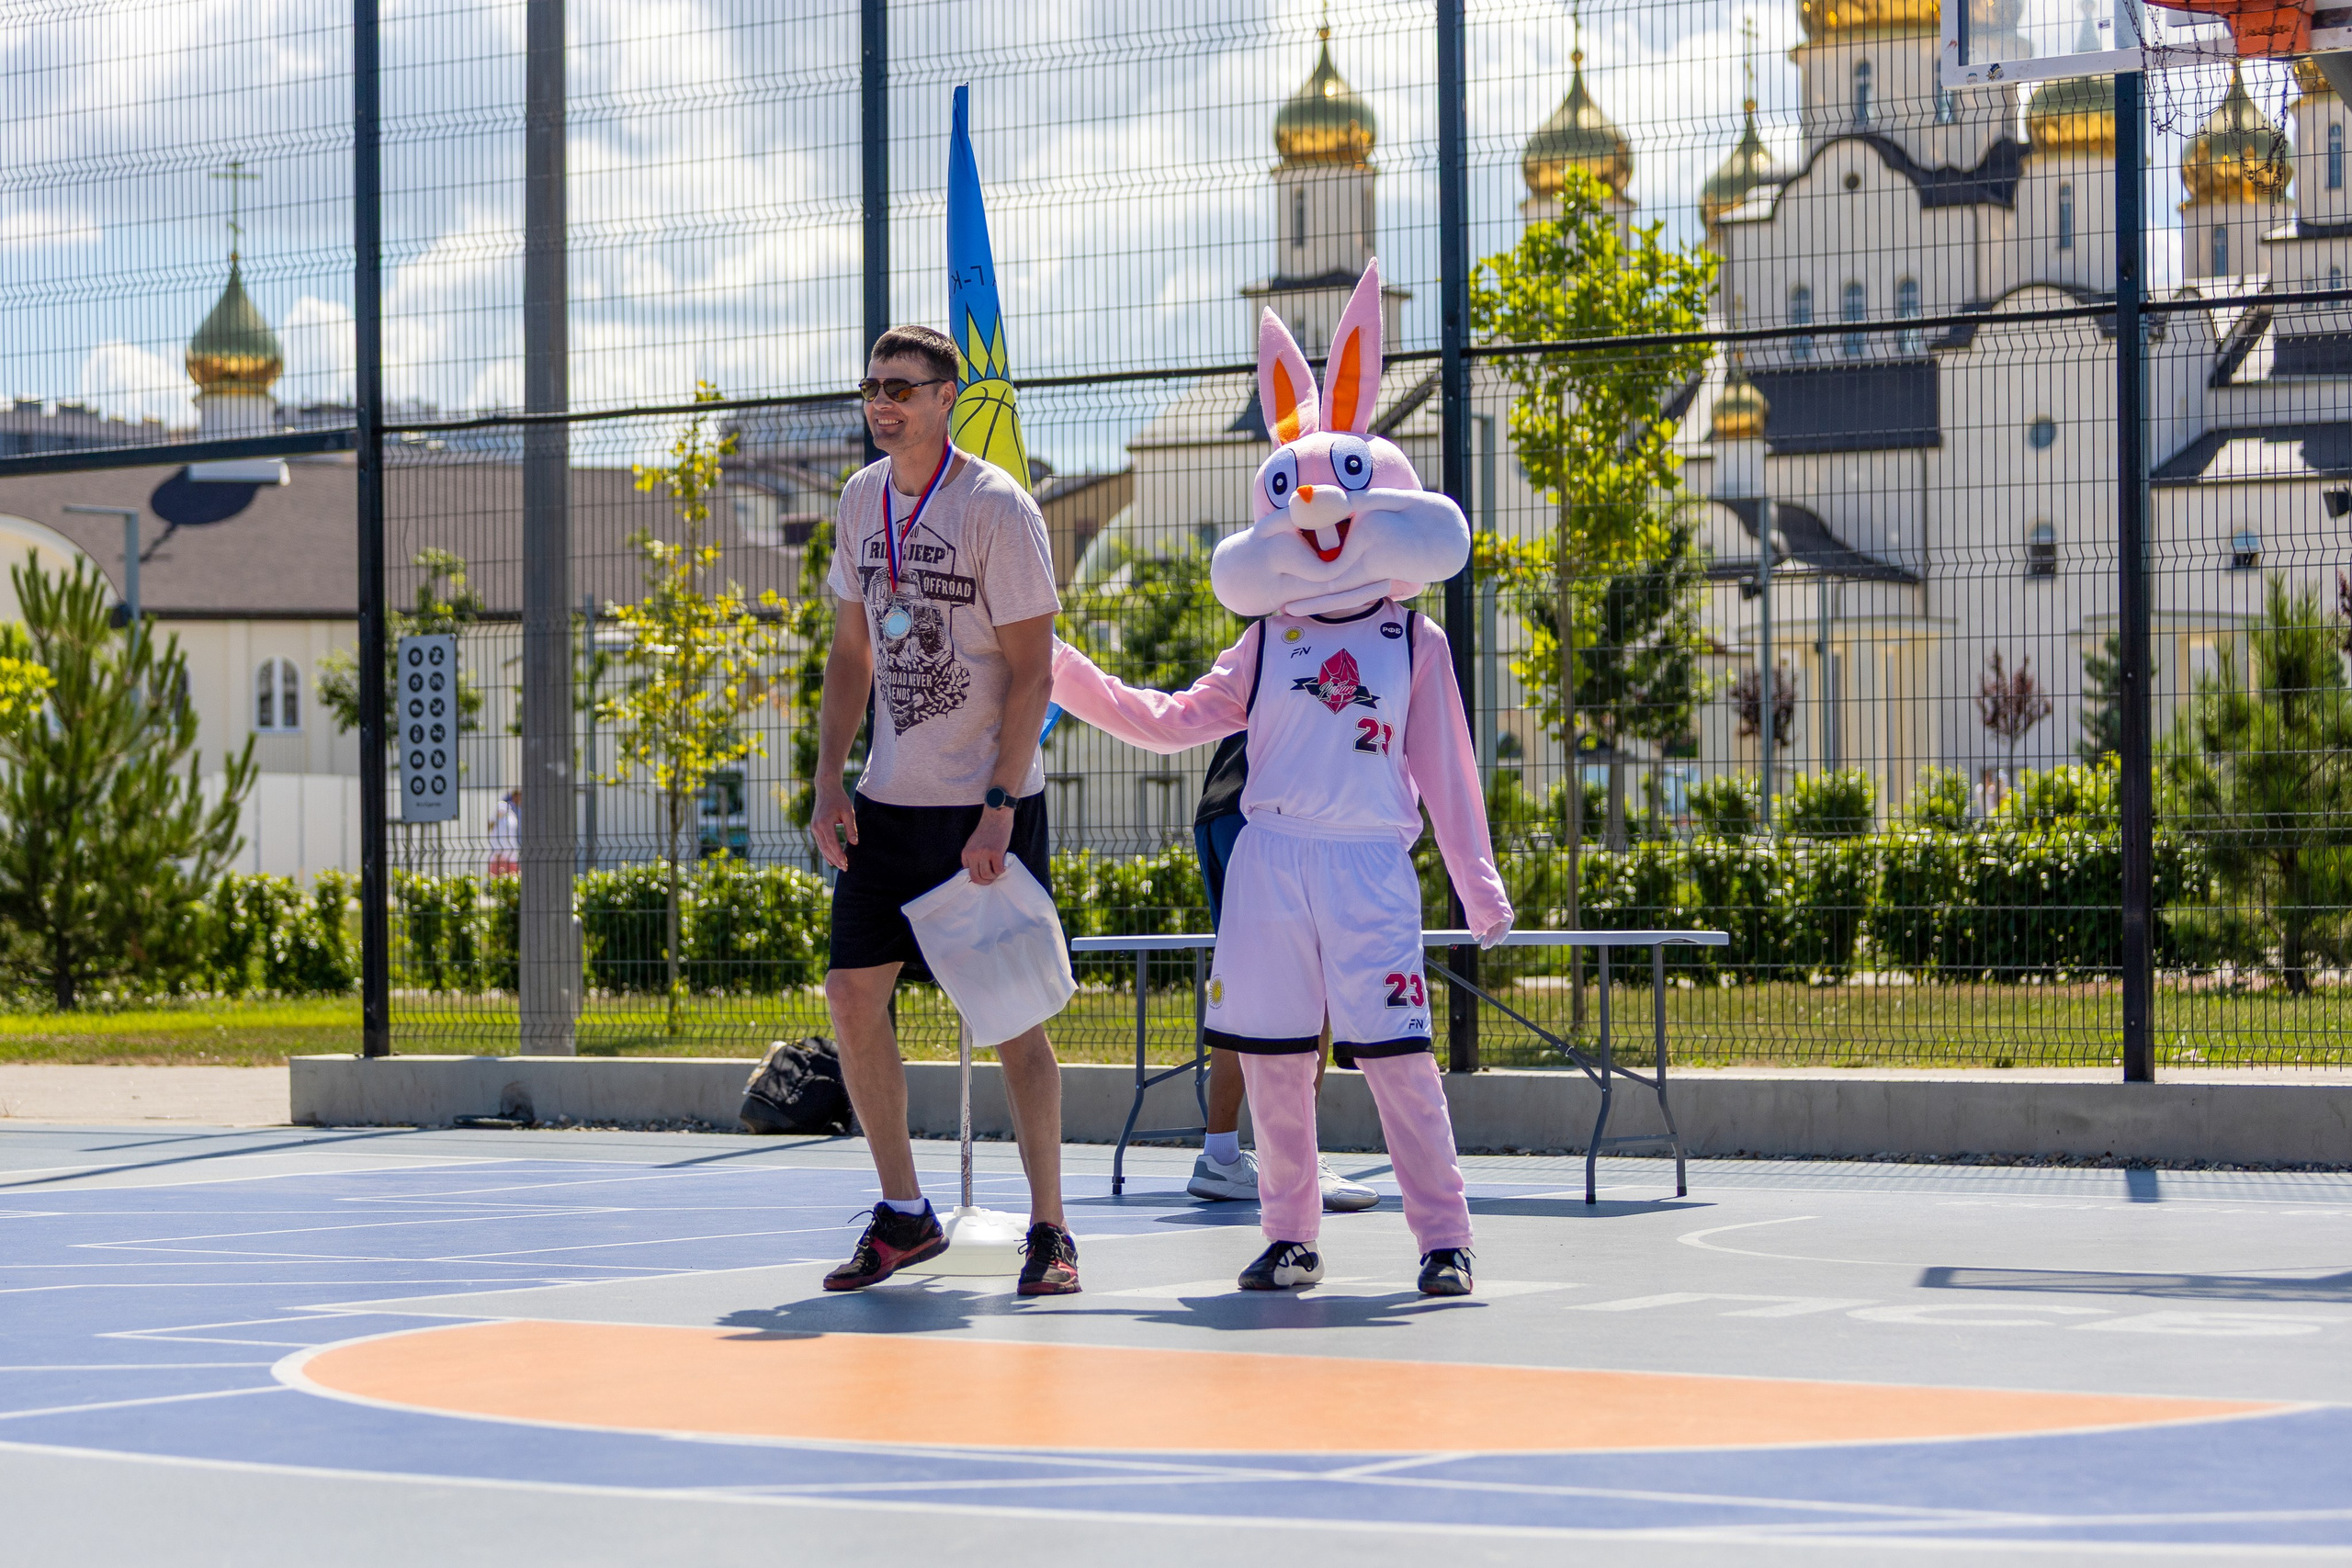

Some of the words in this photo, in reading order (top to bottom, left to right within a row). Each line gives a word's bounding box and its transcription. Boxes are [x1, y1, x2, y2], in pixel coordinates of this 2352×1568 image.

[908, 543, 946, 565] JEEP
[923, 576, 972, 598] OFFROAD
[908, 672, 933, 687] NEVER
[891, 687, 910, 701] ENDS
[1383, 970, 1426, 1010] 23
[1408, 1018, 1424, 1030] FN
